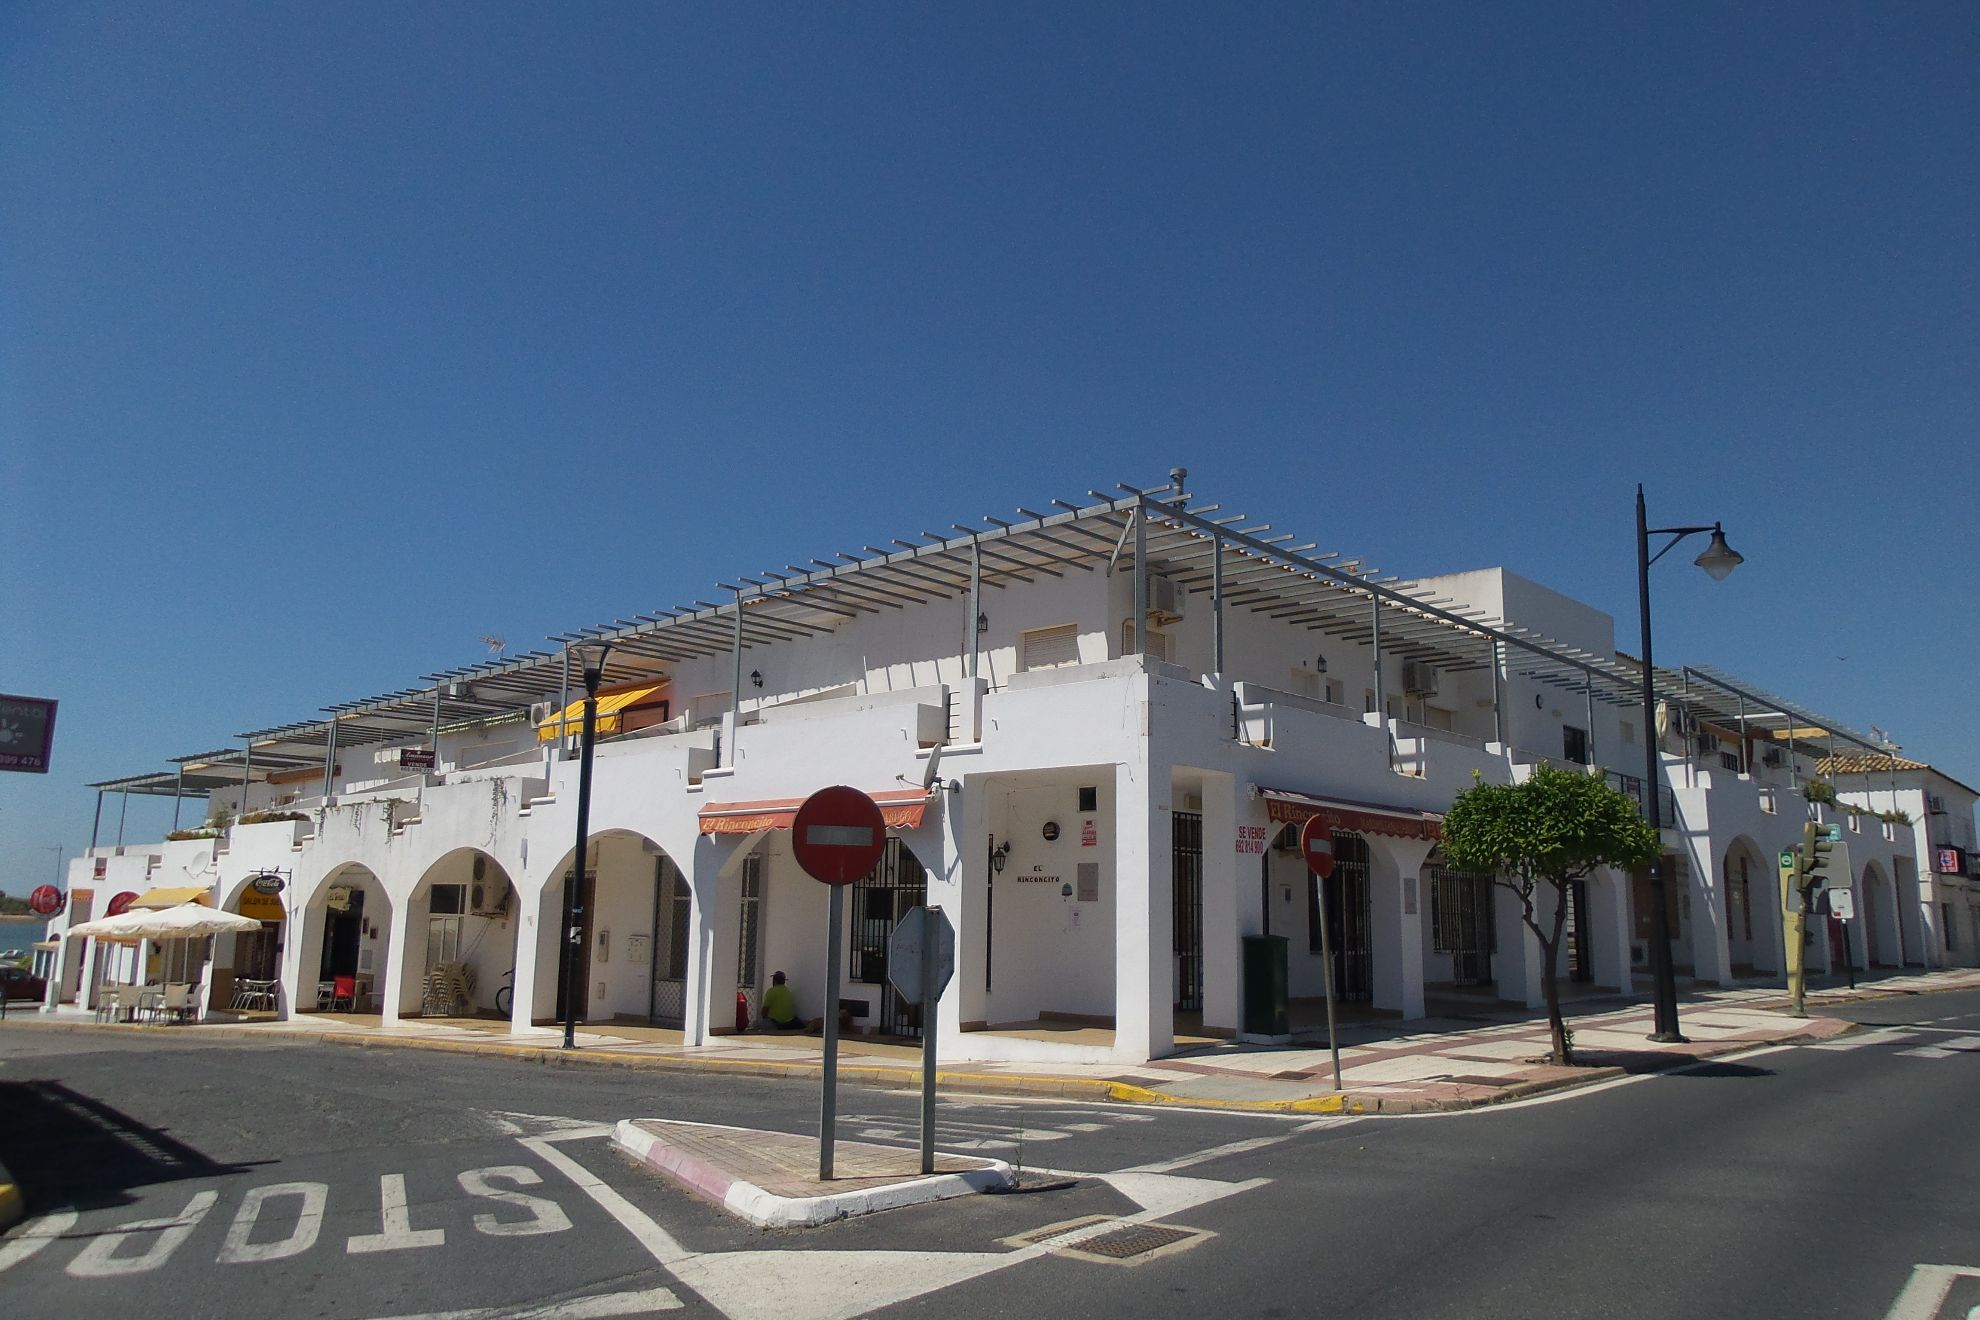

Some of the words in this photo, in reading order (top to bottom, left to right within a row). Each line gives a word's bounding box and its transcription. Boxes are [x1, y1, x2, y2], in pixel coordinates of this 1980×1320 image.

[703, 818, 715, 830] El
[715, 816, 776, 830] Rinconcito
[1238, 826, 1246, 838] SE
[1247, 826, 1266, 840] VENDE
[66, 1165, 573, 1277] STOP
